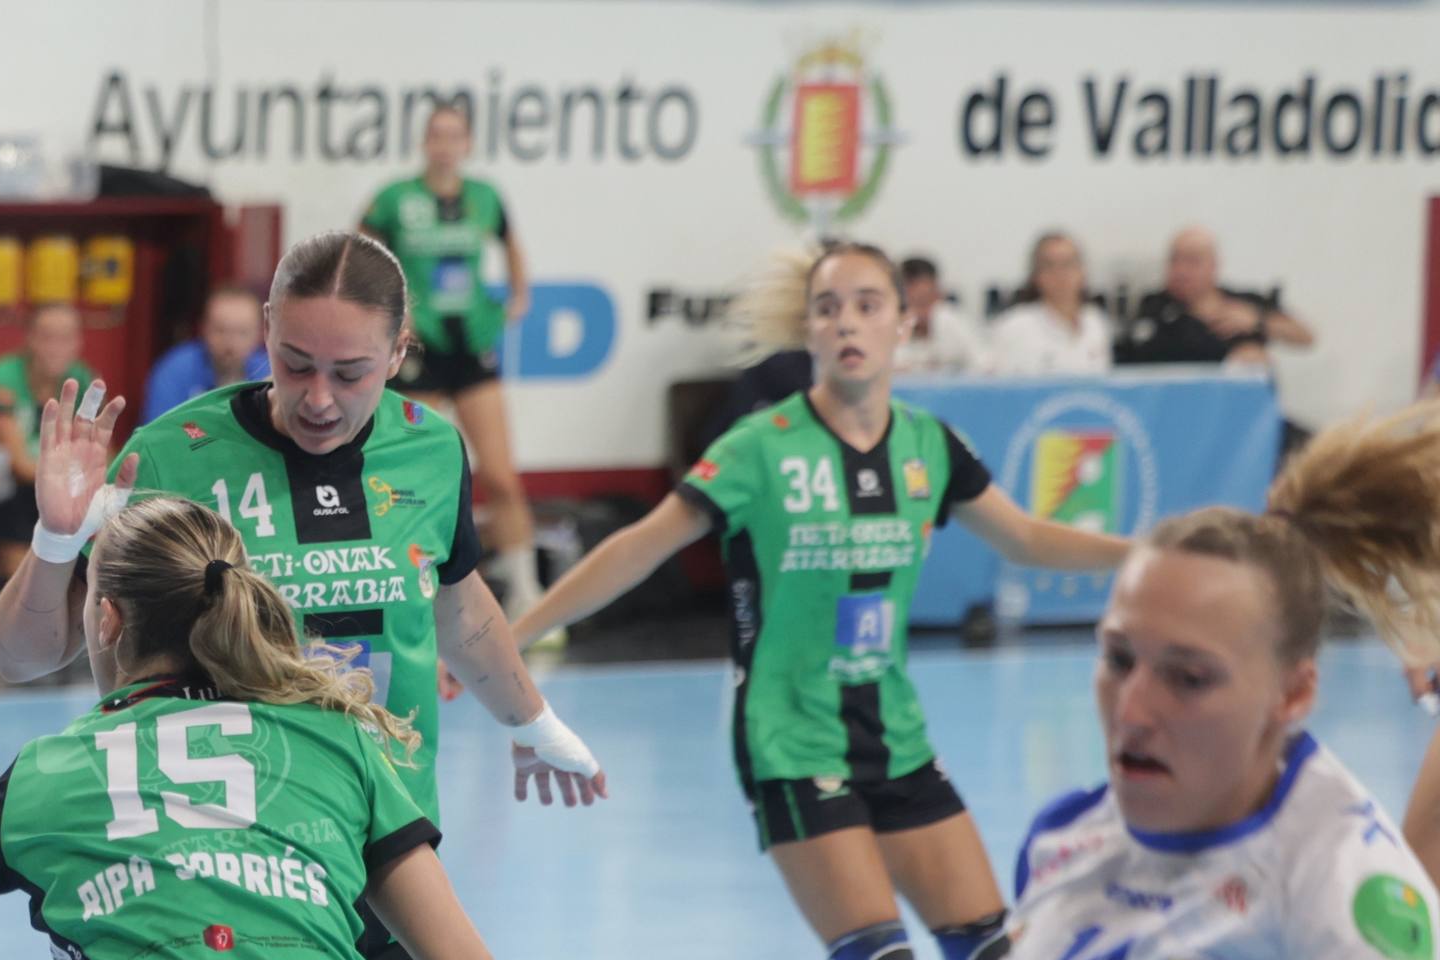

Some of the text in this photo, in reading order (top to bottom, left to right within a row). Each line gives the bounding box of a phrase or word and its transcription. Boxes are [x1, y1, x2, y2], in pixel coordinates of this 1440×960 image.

[87, 72, 700, 168] Ayuntamiento
[960, 74, 1056, 158] de
[212, 473, 276, 537] 14
[780, 456, 840, 513] 34
[248, 546, 396, 578] ETi-ONAK
[278, 576, 407, 609] RRABiA
[95, 702, 257, 841] 15
[77, 854, 156, 922] RIPA
